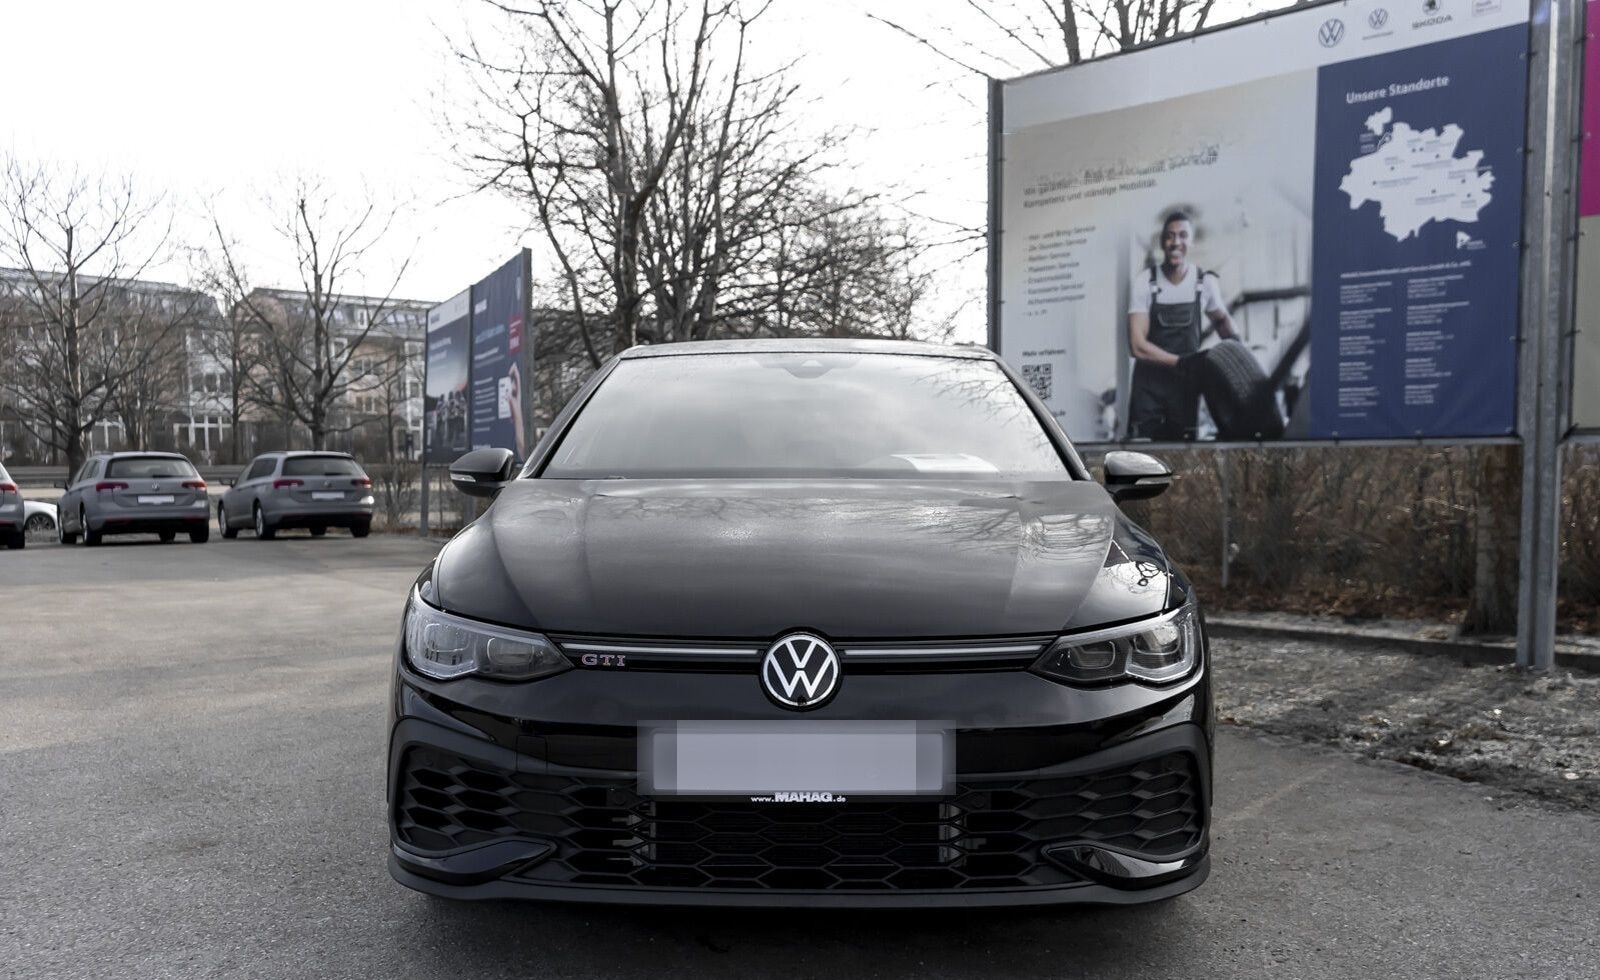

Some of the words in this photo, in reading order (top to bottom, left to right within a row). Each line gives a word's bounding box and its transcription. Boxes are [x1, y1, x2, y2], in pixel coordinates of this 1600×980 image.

[1346, 88, 1386, 104] Unsere
[1388, 76, 1449, 97] Standorte
[582, 653, 626, 667] GTI
[751, 792, 846, 803] www.MAHAG.de
